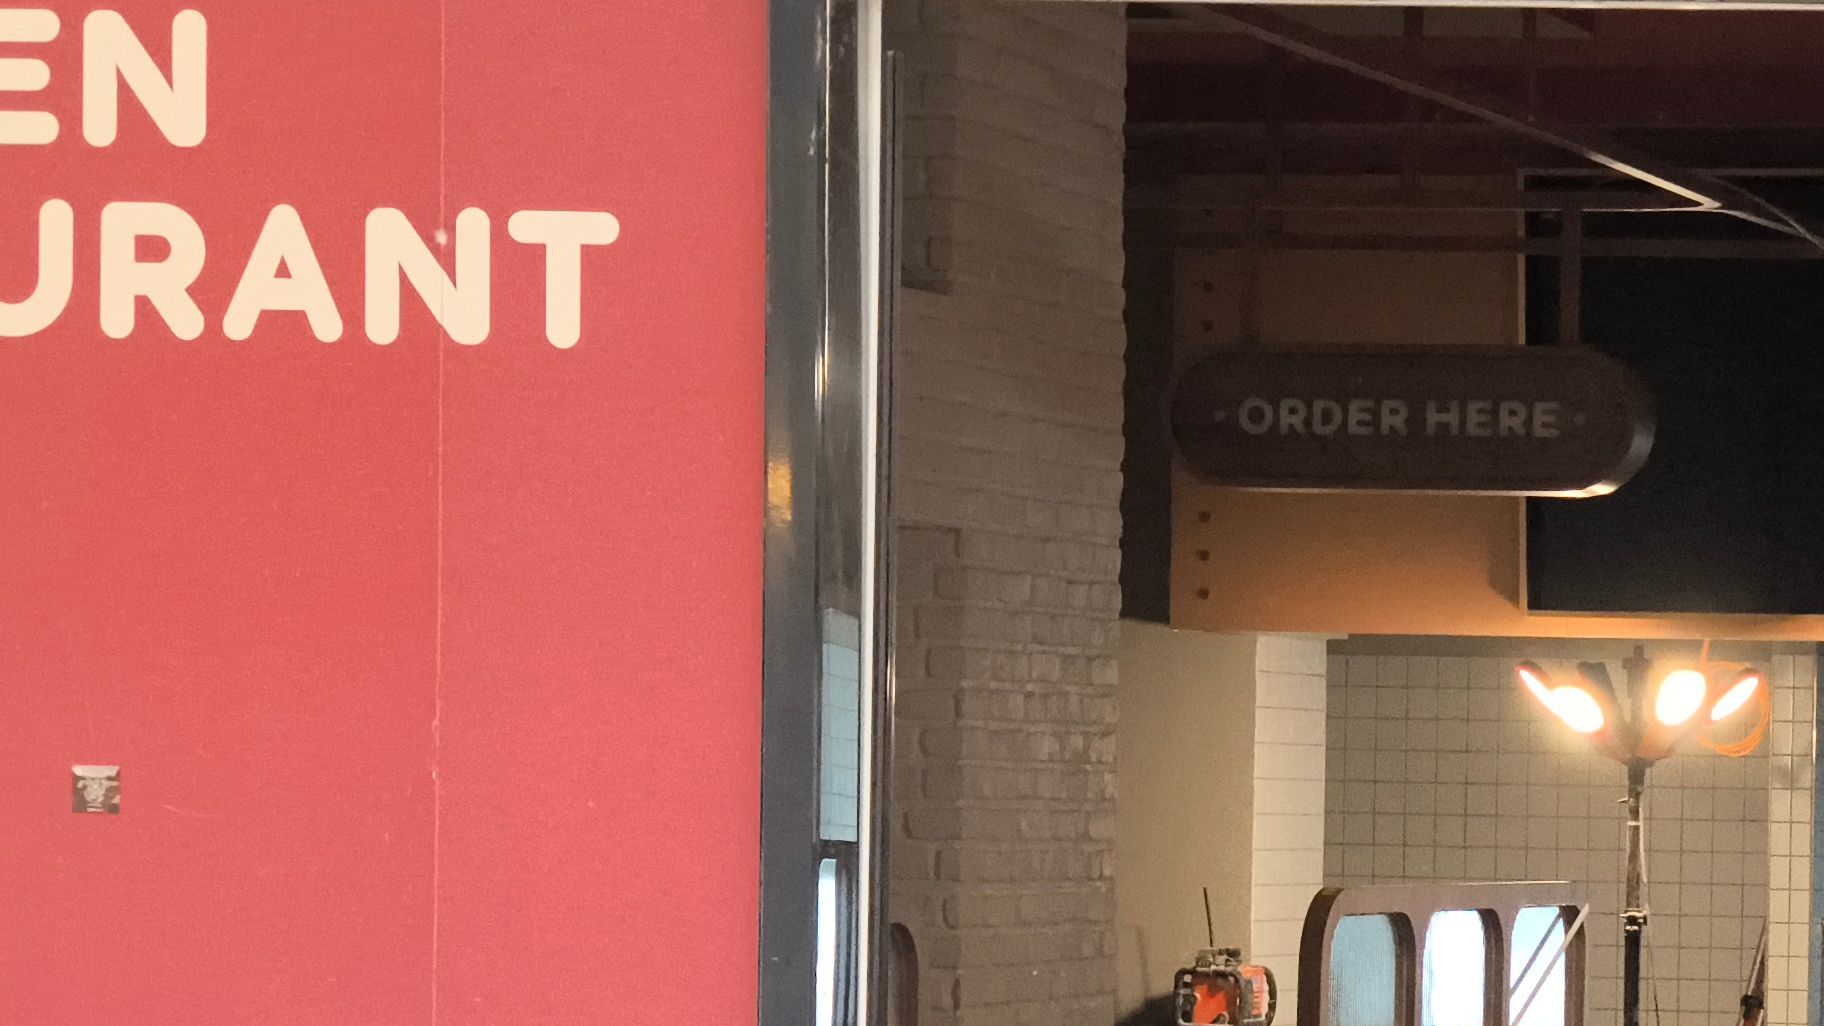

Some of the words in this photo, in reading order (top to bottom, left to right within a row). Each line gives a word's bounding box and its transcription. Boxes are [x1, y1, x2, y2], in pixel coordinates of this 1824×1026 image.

[0, 9, 207, 147] EN
[0, 199, 620, 349] URANT
[1237, 396, 1409, 437] ORDER
[1425, 399, 1561, 439] HERE
